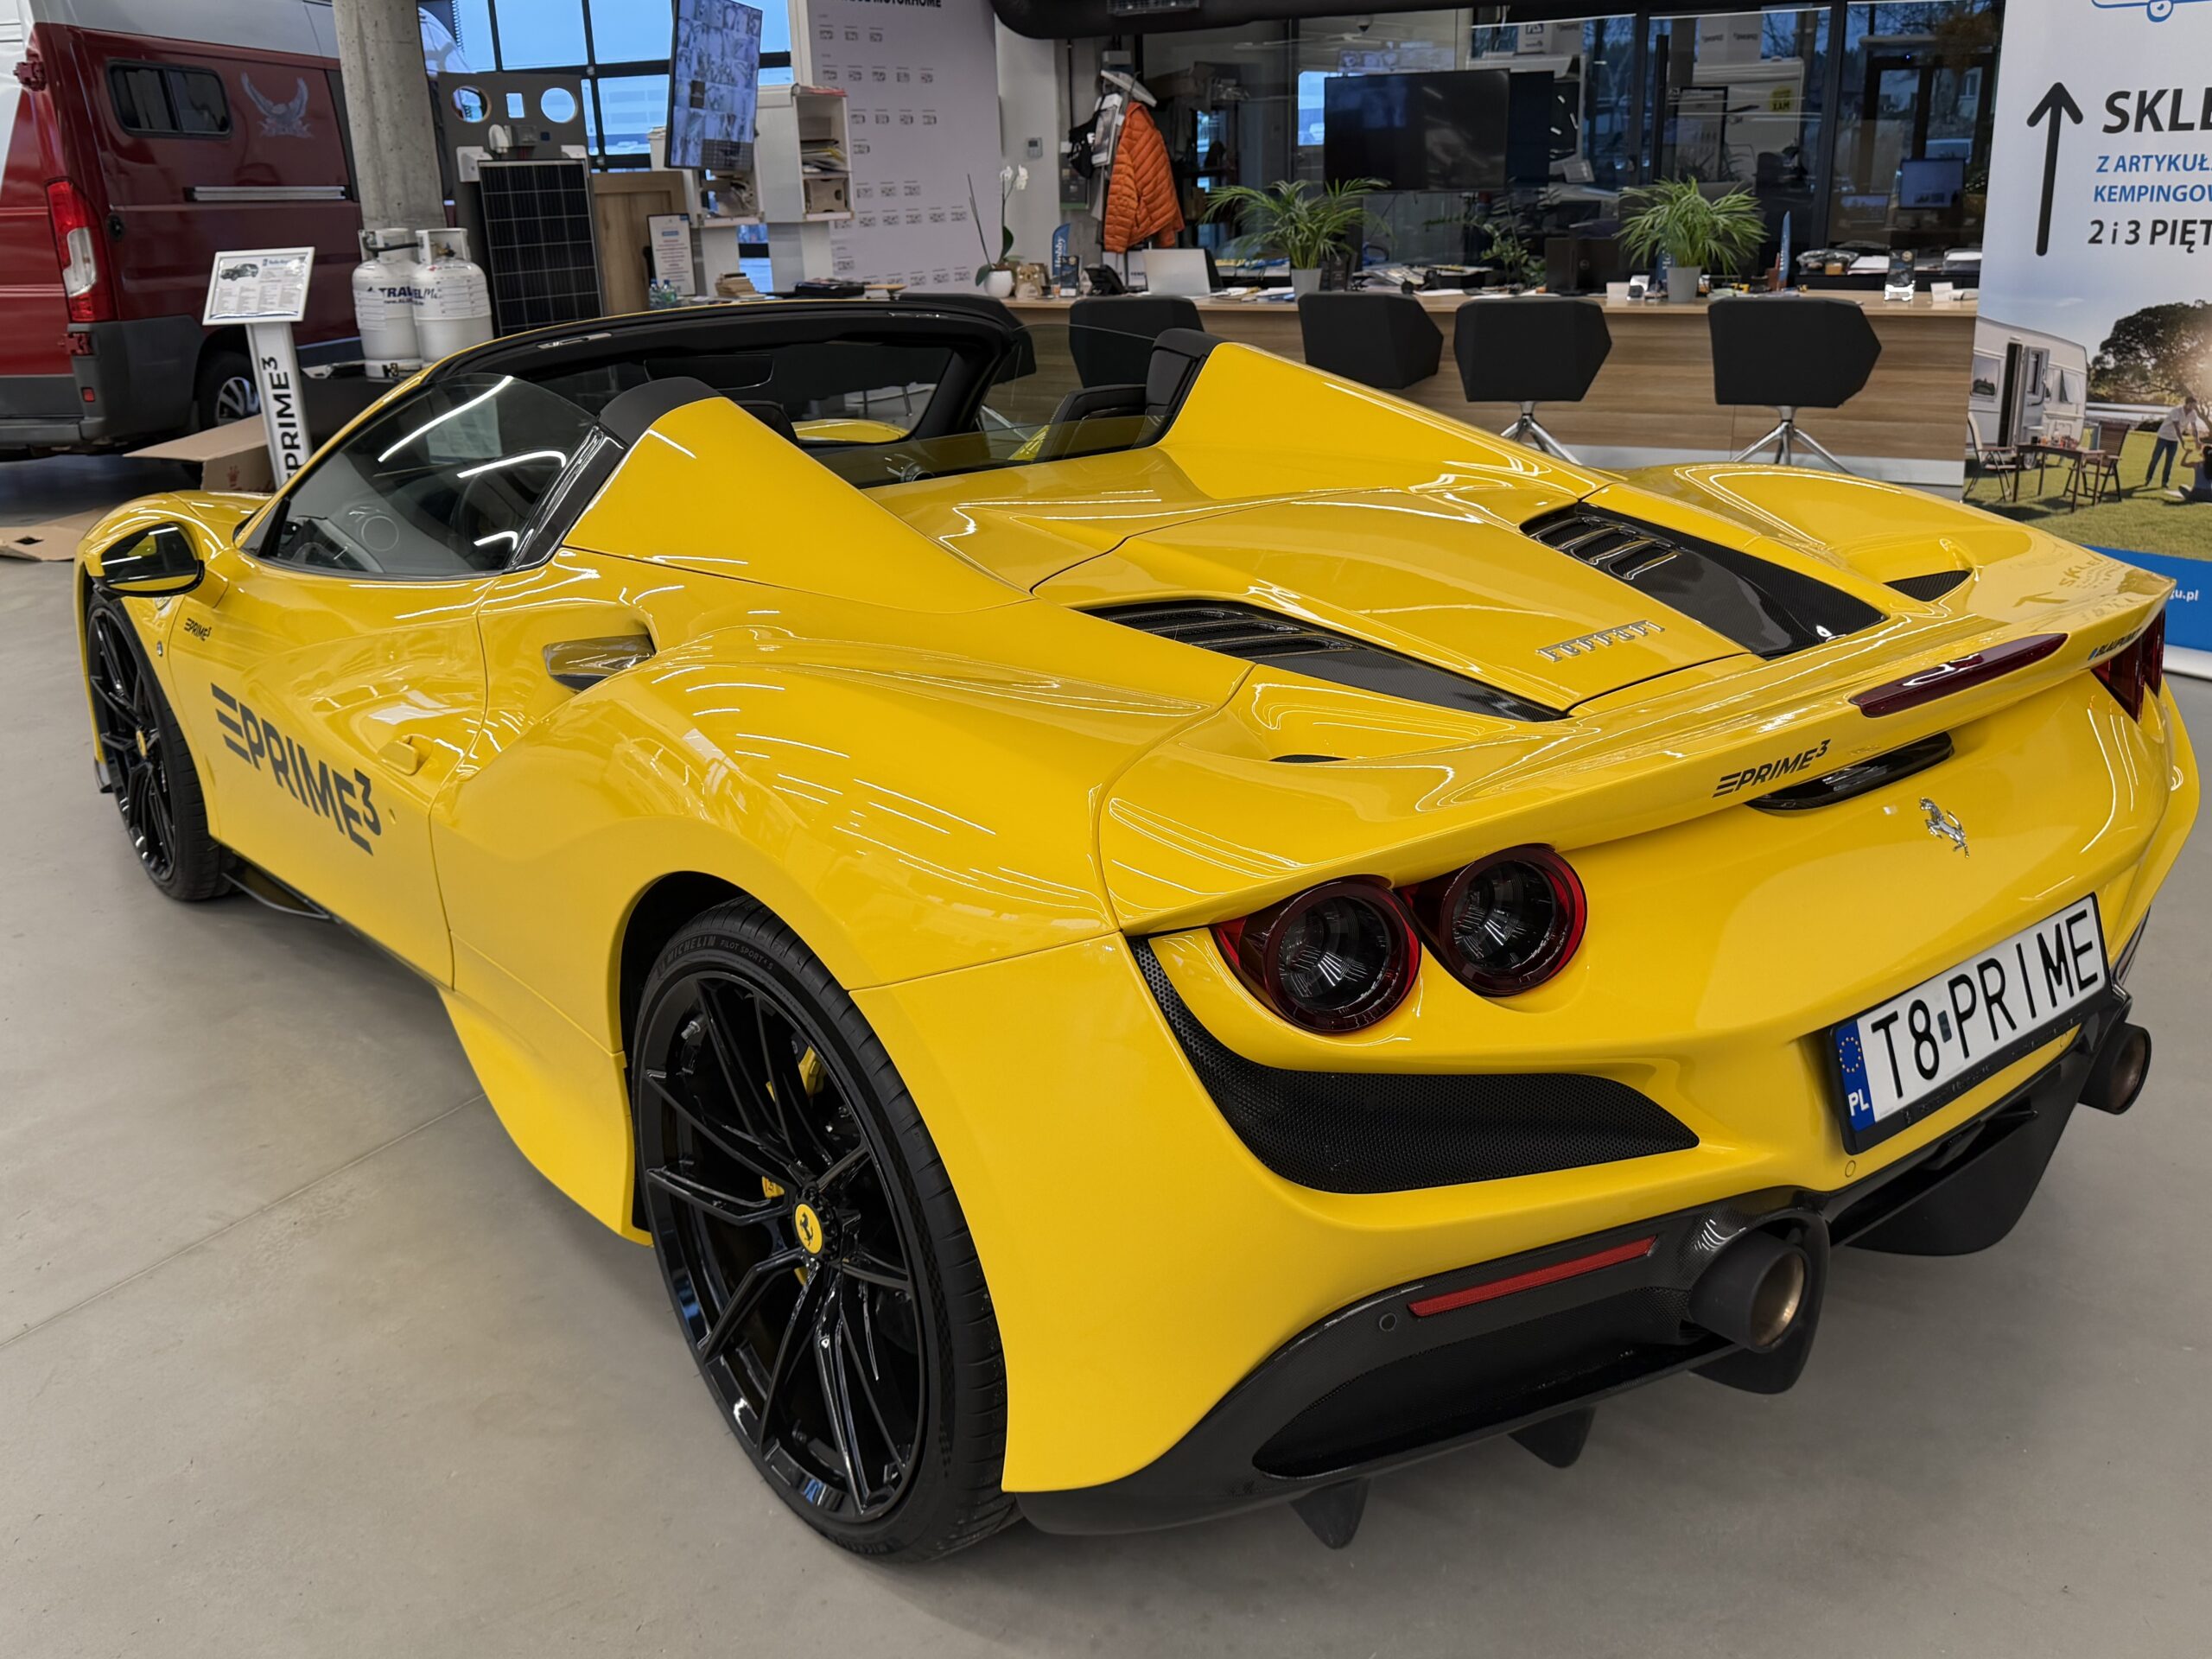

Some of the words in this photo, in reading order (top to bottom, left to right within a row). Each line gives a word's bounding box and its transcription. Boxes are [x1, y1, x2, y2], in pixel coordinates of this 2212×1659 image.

[2096, 156, 2110, 173] Z
[2113, 154, 2212, 173] ARTYKUŁ
[2094, 185, 2212, 203] KEMPINGO
[2088, 219, 2105, 245] 2
[2111, 221, 2119, 245] i
[2124, 219, 2141, 245] 3
[667, 936, 716, 962] MICHELIN
[720, 938, 739, 951] PILOT
[1948, 909, 2099, 1059] PRIME
[1847, 1089, 1870, 1116] PL
